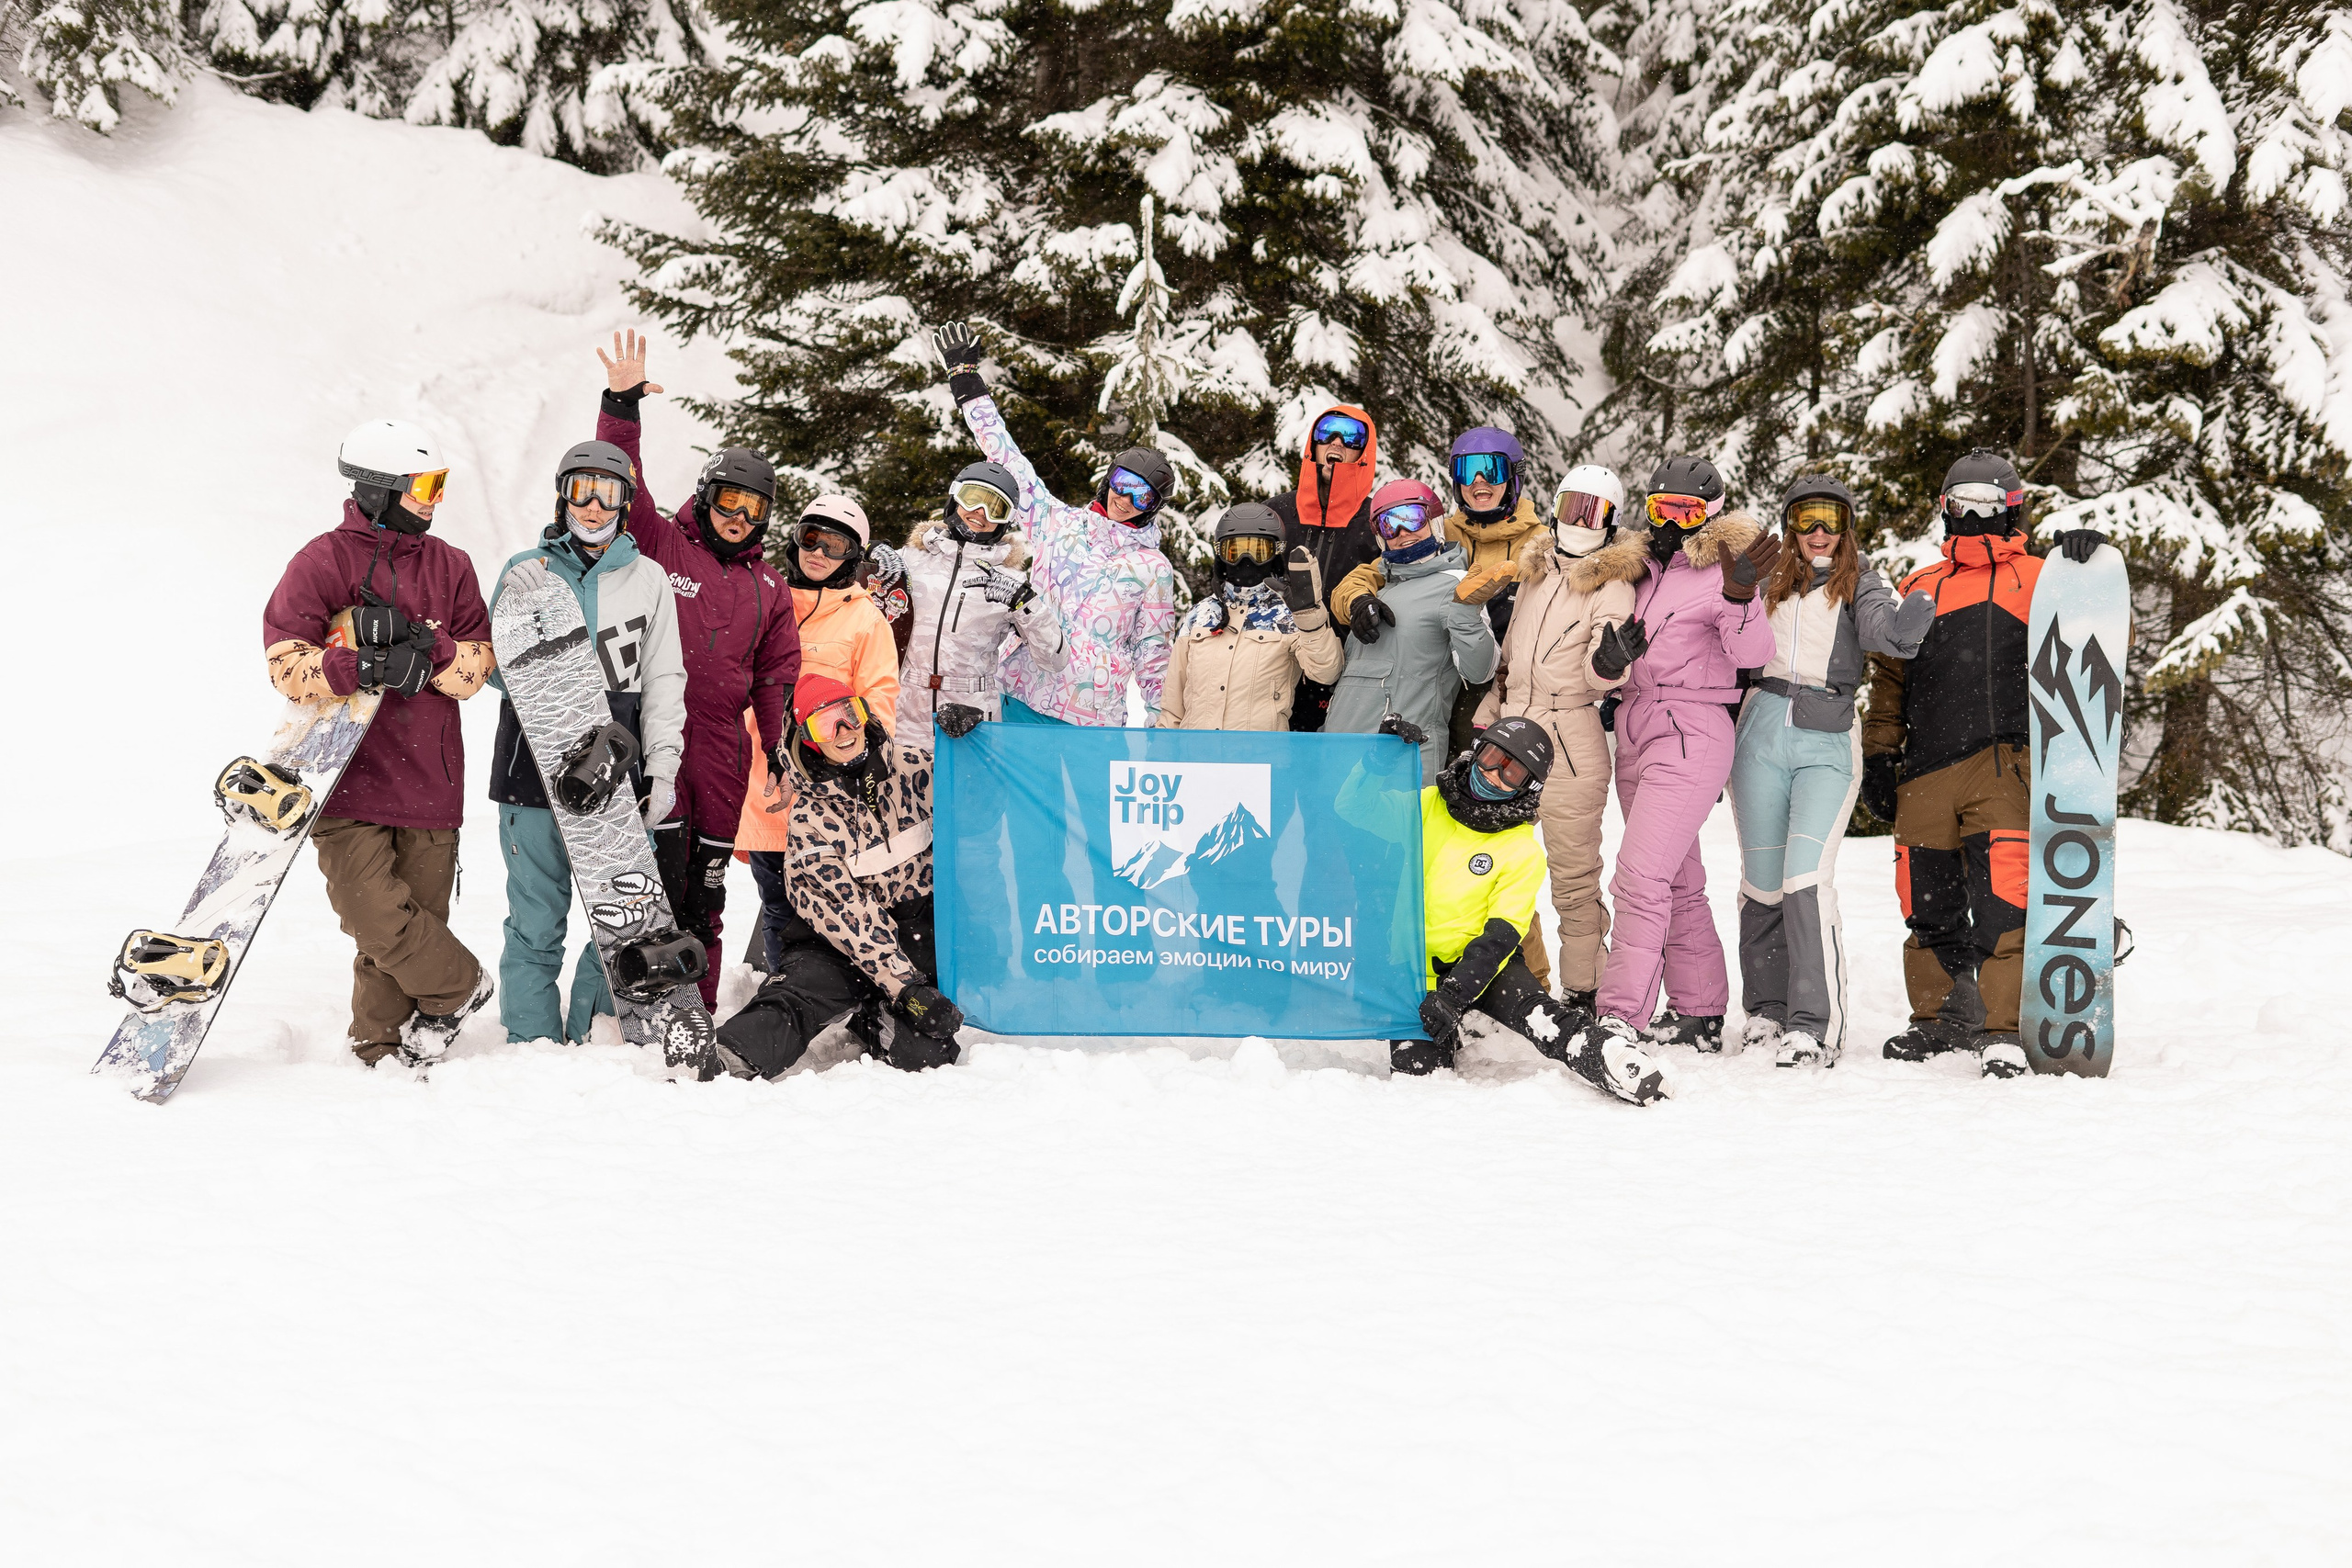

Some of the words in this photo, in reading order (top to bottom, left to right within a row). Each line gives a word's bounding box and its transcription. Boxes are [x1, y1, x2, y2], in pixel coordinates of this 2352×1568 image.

[342, 465, 398, 487] SALICE
[669, 572, 702, 593] SNOW
[1114, 767, 1182, 803] Joy
[1114, 795, 1184, 831] Trip
[1034, 903, 1246, 945] АВТОРСКИЕ
[1253, 916, 1352, 948] ТУРЫ
[1034, 943, 1153, 968] собираем
[1159, 951, 1251, 971] эмоции
[1257, 958, 1285, 972] по
[1291, 960, 1352, 981] миру
